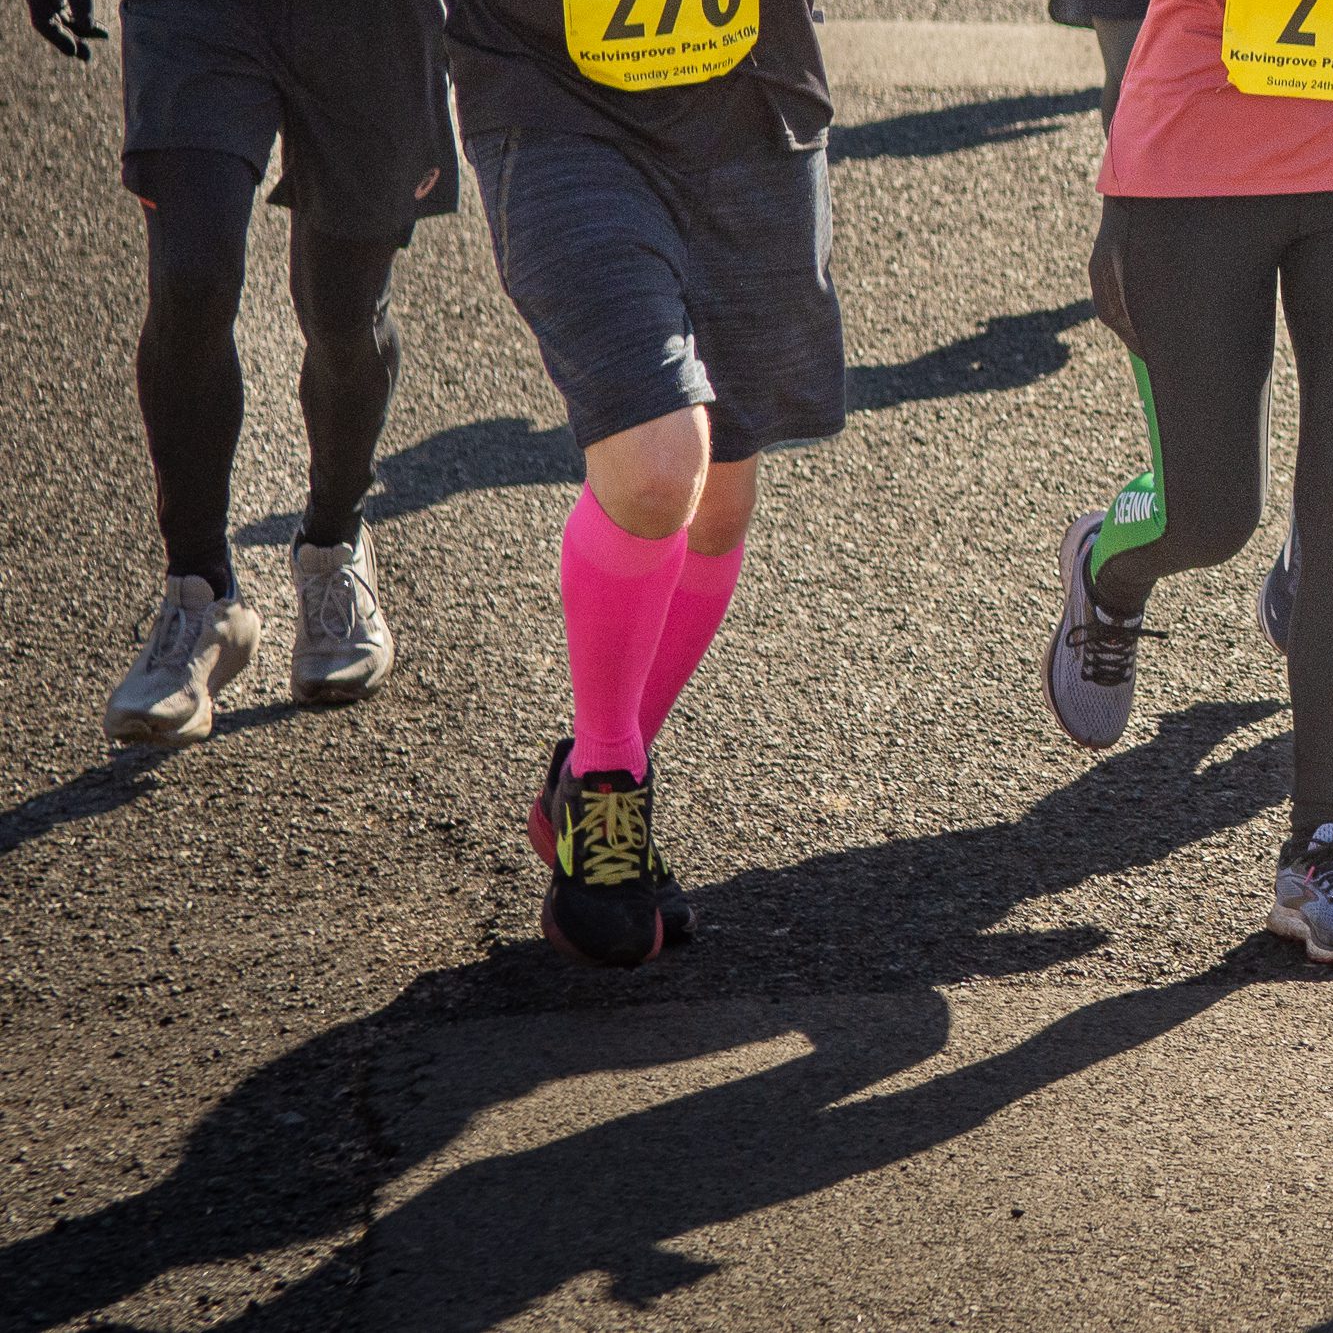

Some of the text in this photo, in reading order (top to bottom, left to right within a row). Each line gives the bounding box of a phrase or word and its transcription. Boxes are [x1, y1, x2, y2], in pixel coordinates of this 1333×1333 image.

[579, 25, 757, 62] Kelvingrove Park 5k/10k
[1230, 49, 1317, 67] Kelvingrove
[624, 57, 733, 82] Sunday 24th March
[1266, 76, 1307, 91] Sunday
[1311, 81, 1333, 91] 24th
